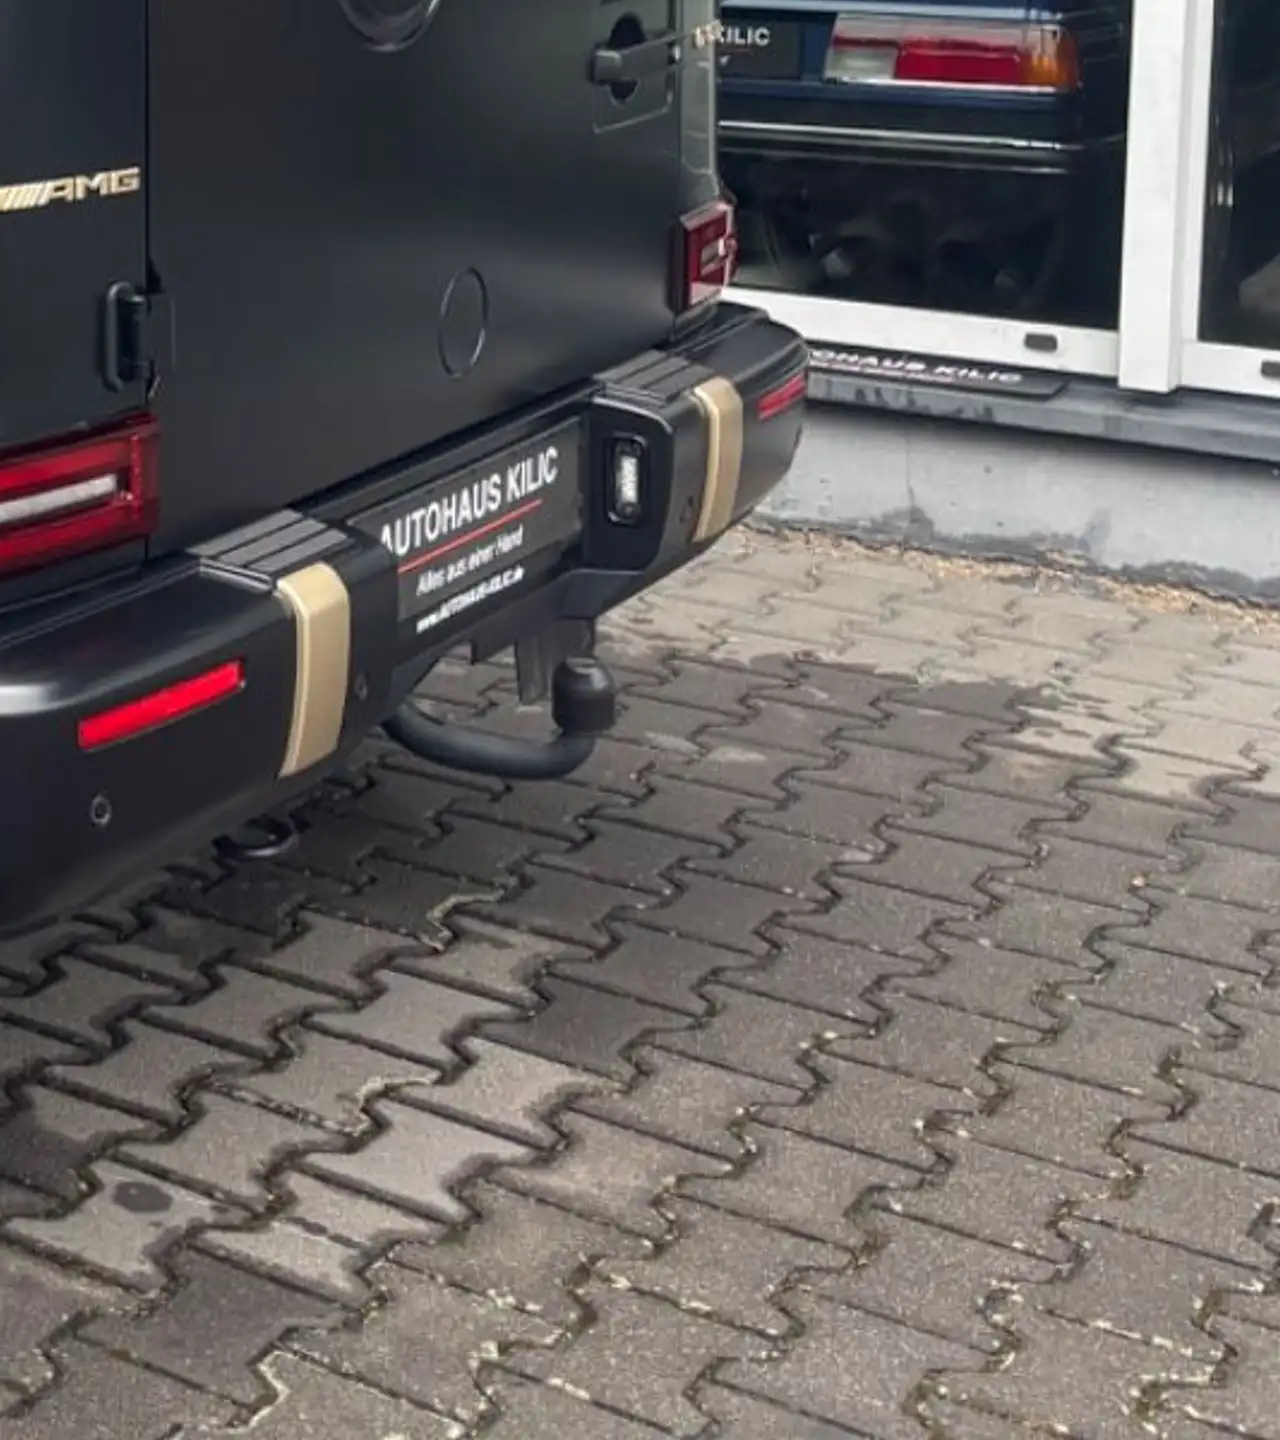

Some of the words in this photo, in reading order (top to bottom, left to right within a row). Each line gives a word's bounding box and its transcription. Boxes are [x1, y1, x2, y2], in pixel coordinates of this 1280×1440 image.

[37, 166, 141, 204] AMG
[381, 472, 502, 556] AUTOHAUS
[506, 445, 559, 503] KILIC
